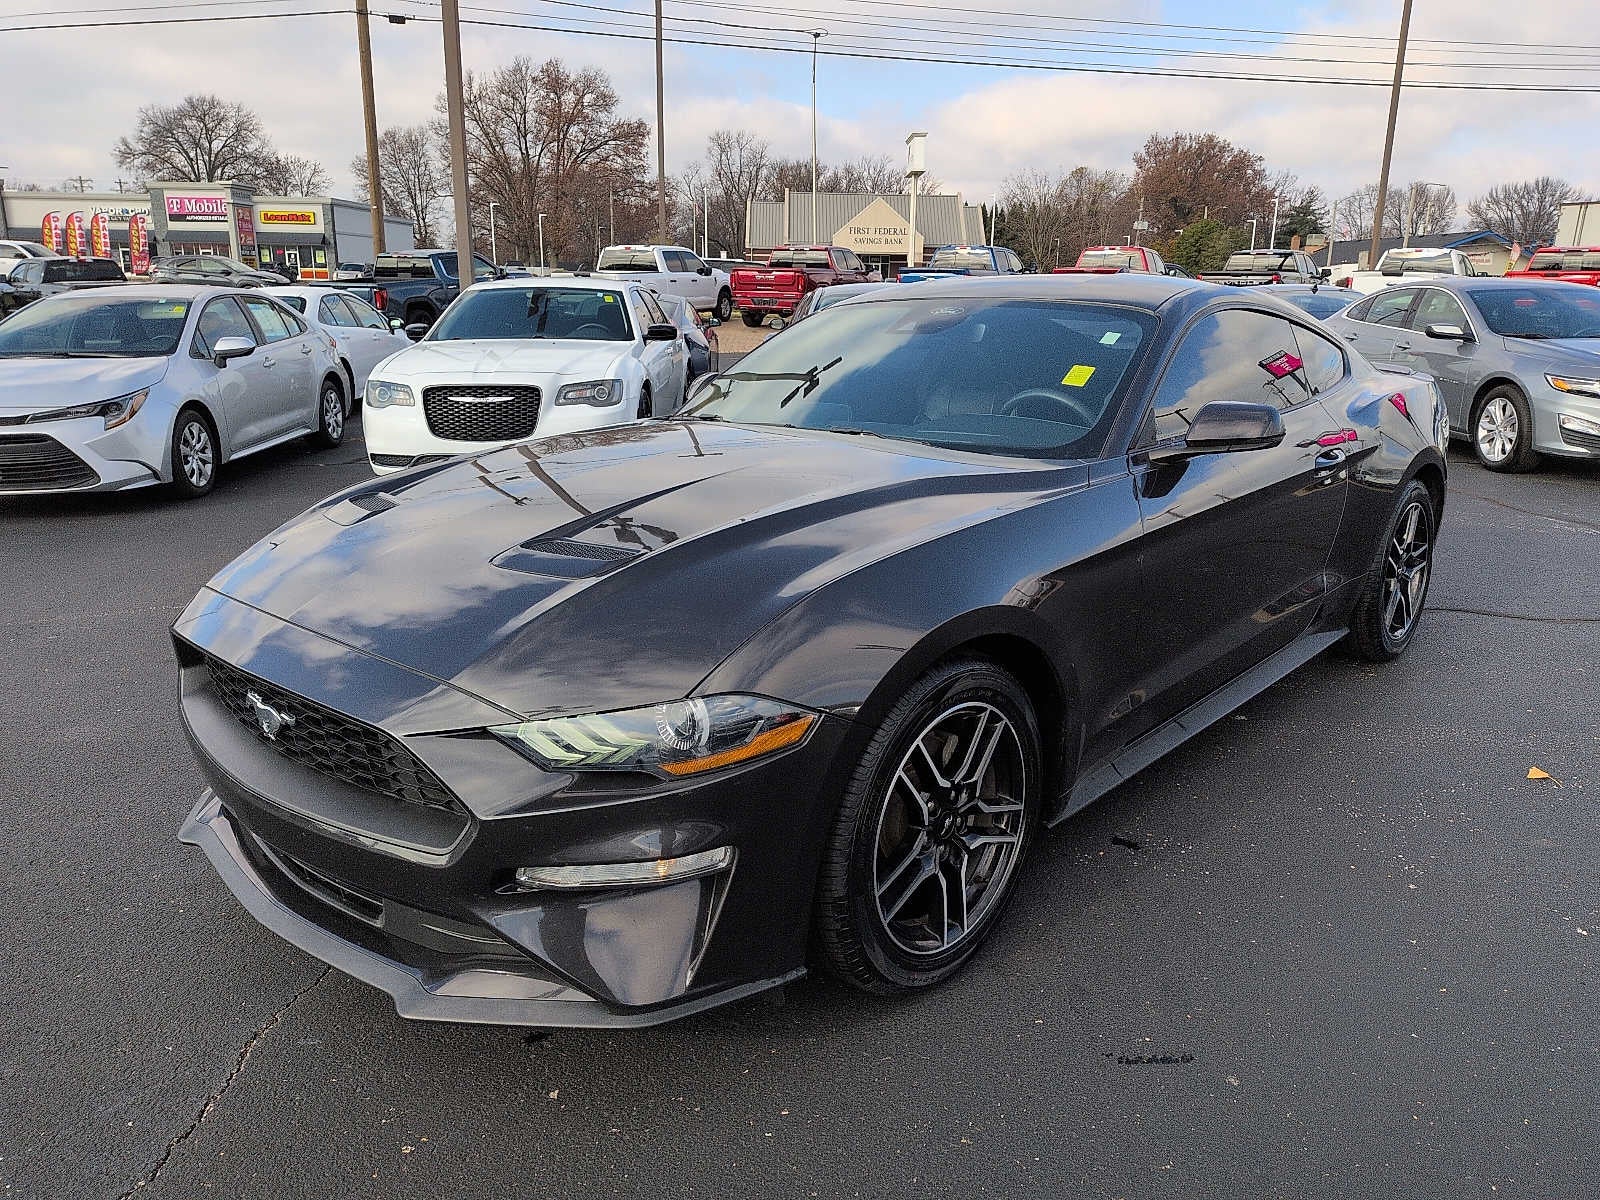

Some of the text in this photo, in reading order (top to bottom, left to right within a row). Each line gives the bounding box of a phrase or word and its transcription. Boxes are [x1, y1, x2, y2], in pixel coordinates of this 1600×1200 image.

[90, 207, 122, 215] VAPOR
[184, 199, 229, 213] Mobile
[263, 212, 311, 222] LoanMax
[849, 226, 908, 236] FIRST FEDERAL
[854, 237, 882, 245] SAVINGS
